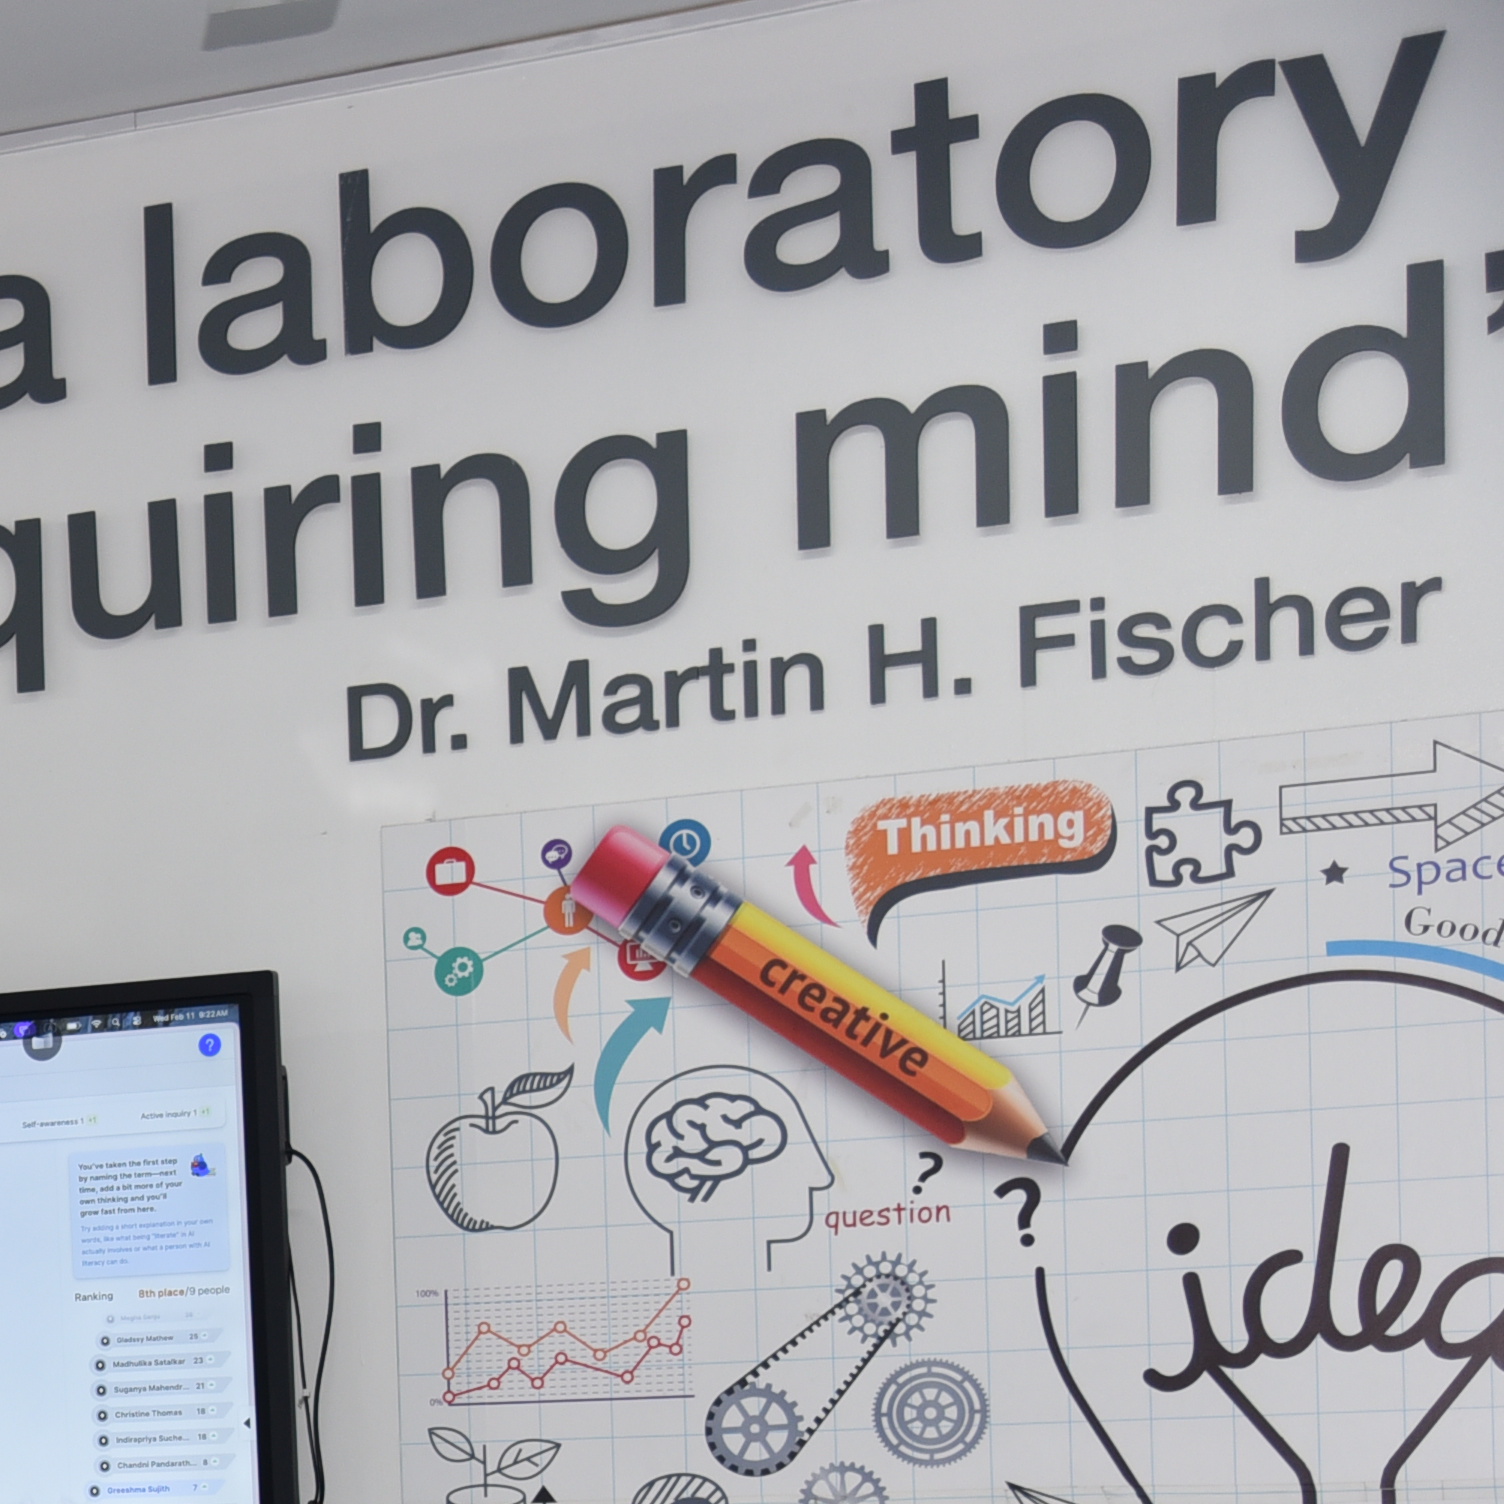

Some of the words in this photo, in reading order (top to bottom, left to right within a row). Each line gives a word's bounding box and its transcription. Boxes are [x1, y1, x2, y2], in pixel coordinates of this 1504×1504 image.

[144, 30, 1446, 386] laboratory
[347, 682, 468, 762] Dr.
[508, 638, 825, 745] Martin
[869, 616, 972, 705] H.
[1020, 576, 1442, 688] Fischer
[878, 803, 1086, 859] Thinking
[760, 958, 929, 1077] creative
[825, 1200, 951, 1231] question
[75, 1291, 114, 1302] Ranking
[138, 1289, 156, 1298] 8th
[158, 1286, 196, 1299] place/9
[198, 1285, 230, 1296] people
[416, 1289, 439, 1298] 100%
